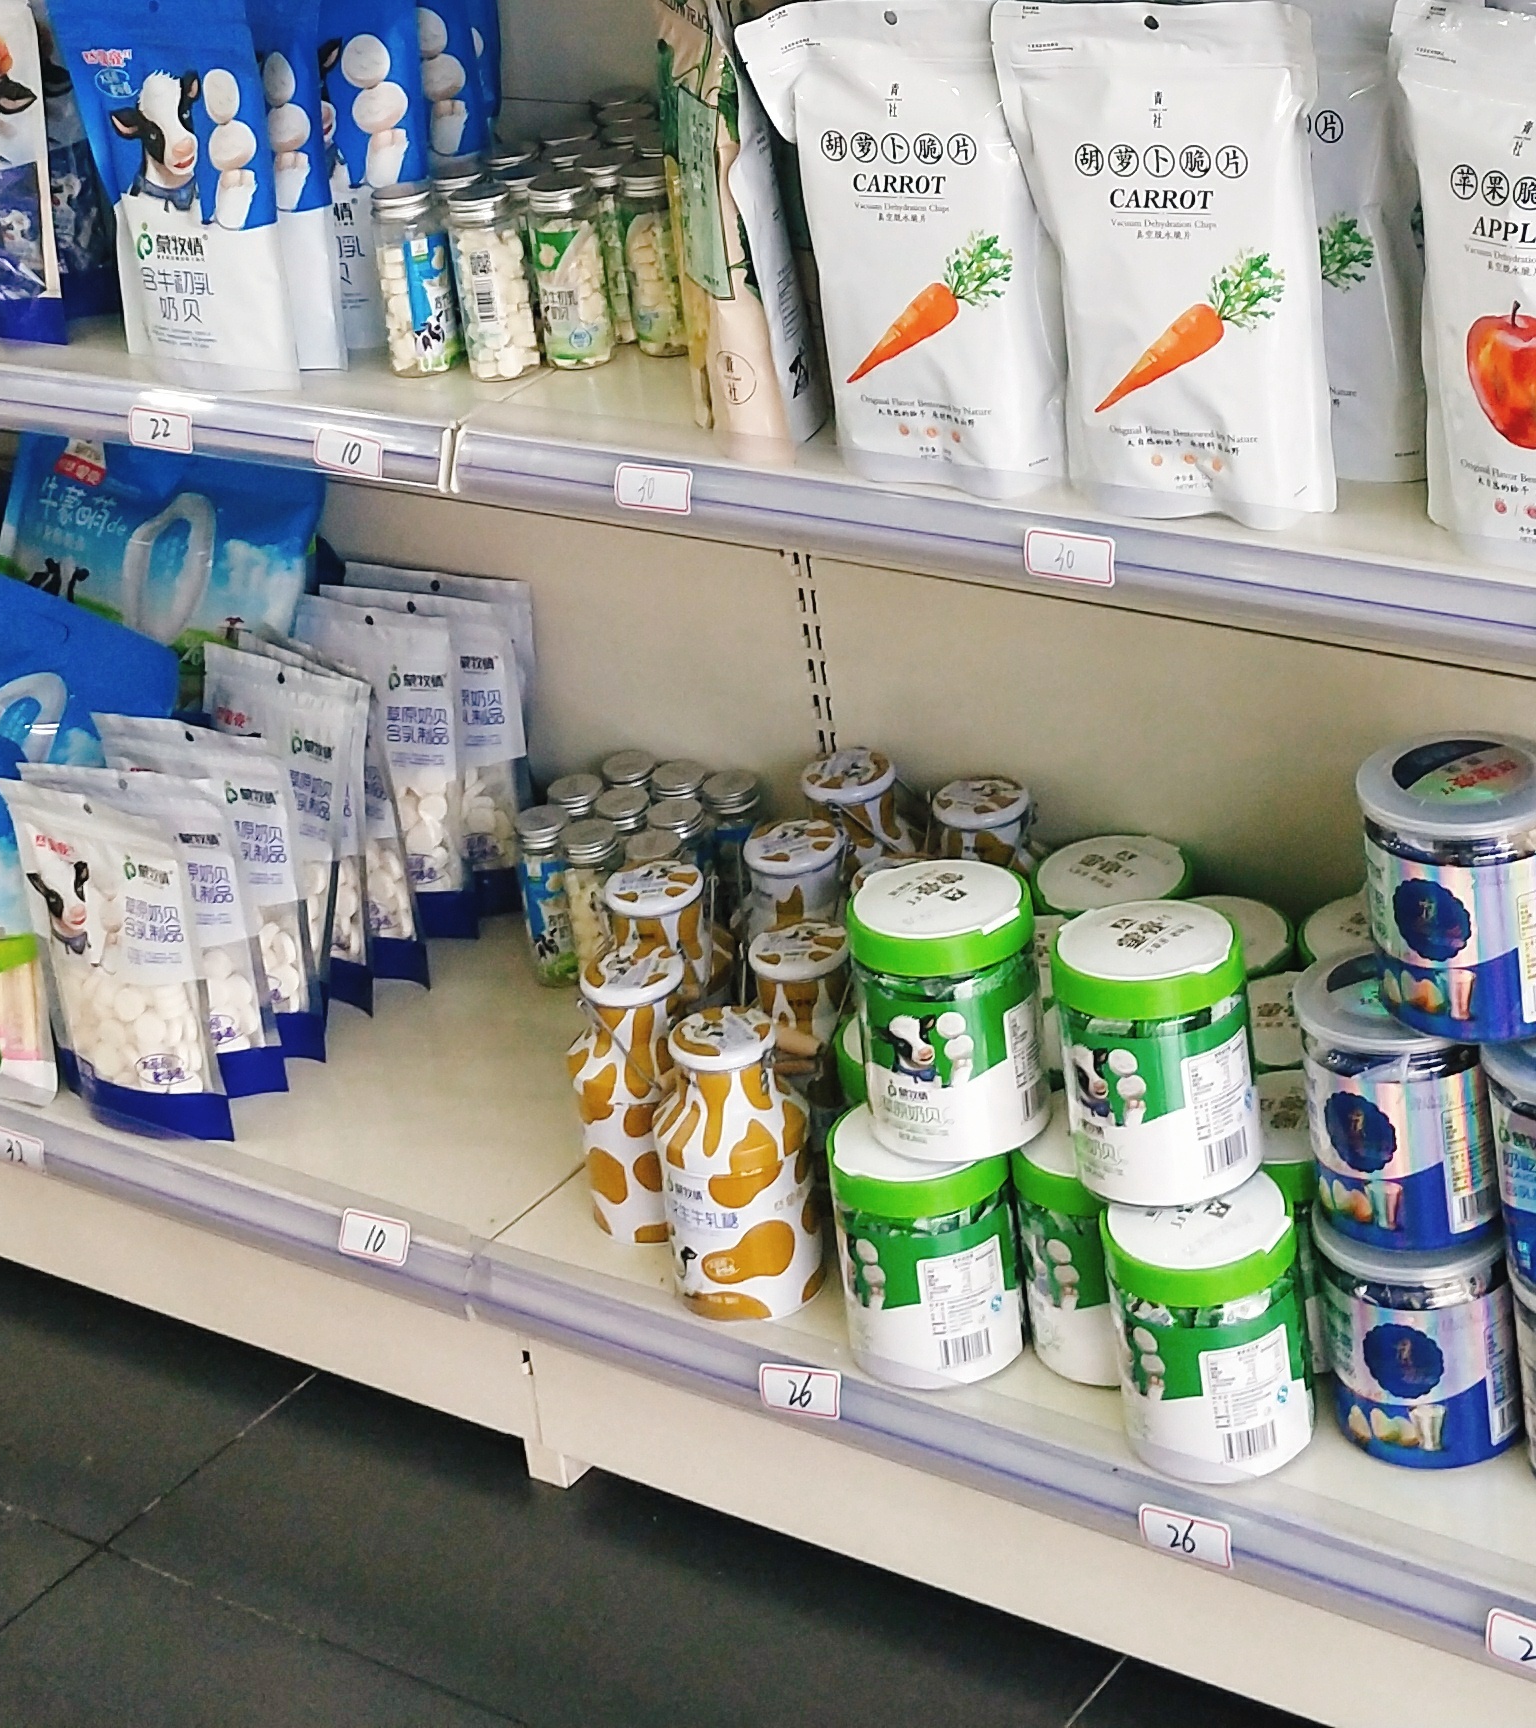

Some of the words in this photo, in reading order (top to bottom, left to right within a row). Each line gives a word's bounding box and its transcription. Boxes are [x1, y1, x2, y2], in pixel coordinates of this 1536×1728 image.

[820, 130, 978, 165] 胡萝卜脆片
[1073, 144, 1249, 179] 胡萝卜脆片
[852, 173, 946, 196] CARROT
[1108, 188, 1214, 211] CARROT
[155, 233, 206, 257] 蒙牧情
[142, 266, 215, 294] 含牛初乳
[159, 296, 203, 324] 奶贝
[149, 417, 171, 440] 22
[341, 441, 362, 466] 10
[365, 1223, 387, 1253] 10
[787, 1372, 813, 1408] 26
[1166, 1518, 1197, 1553] 26
